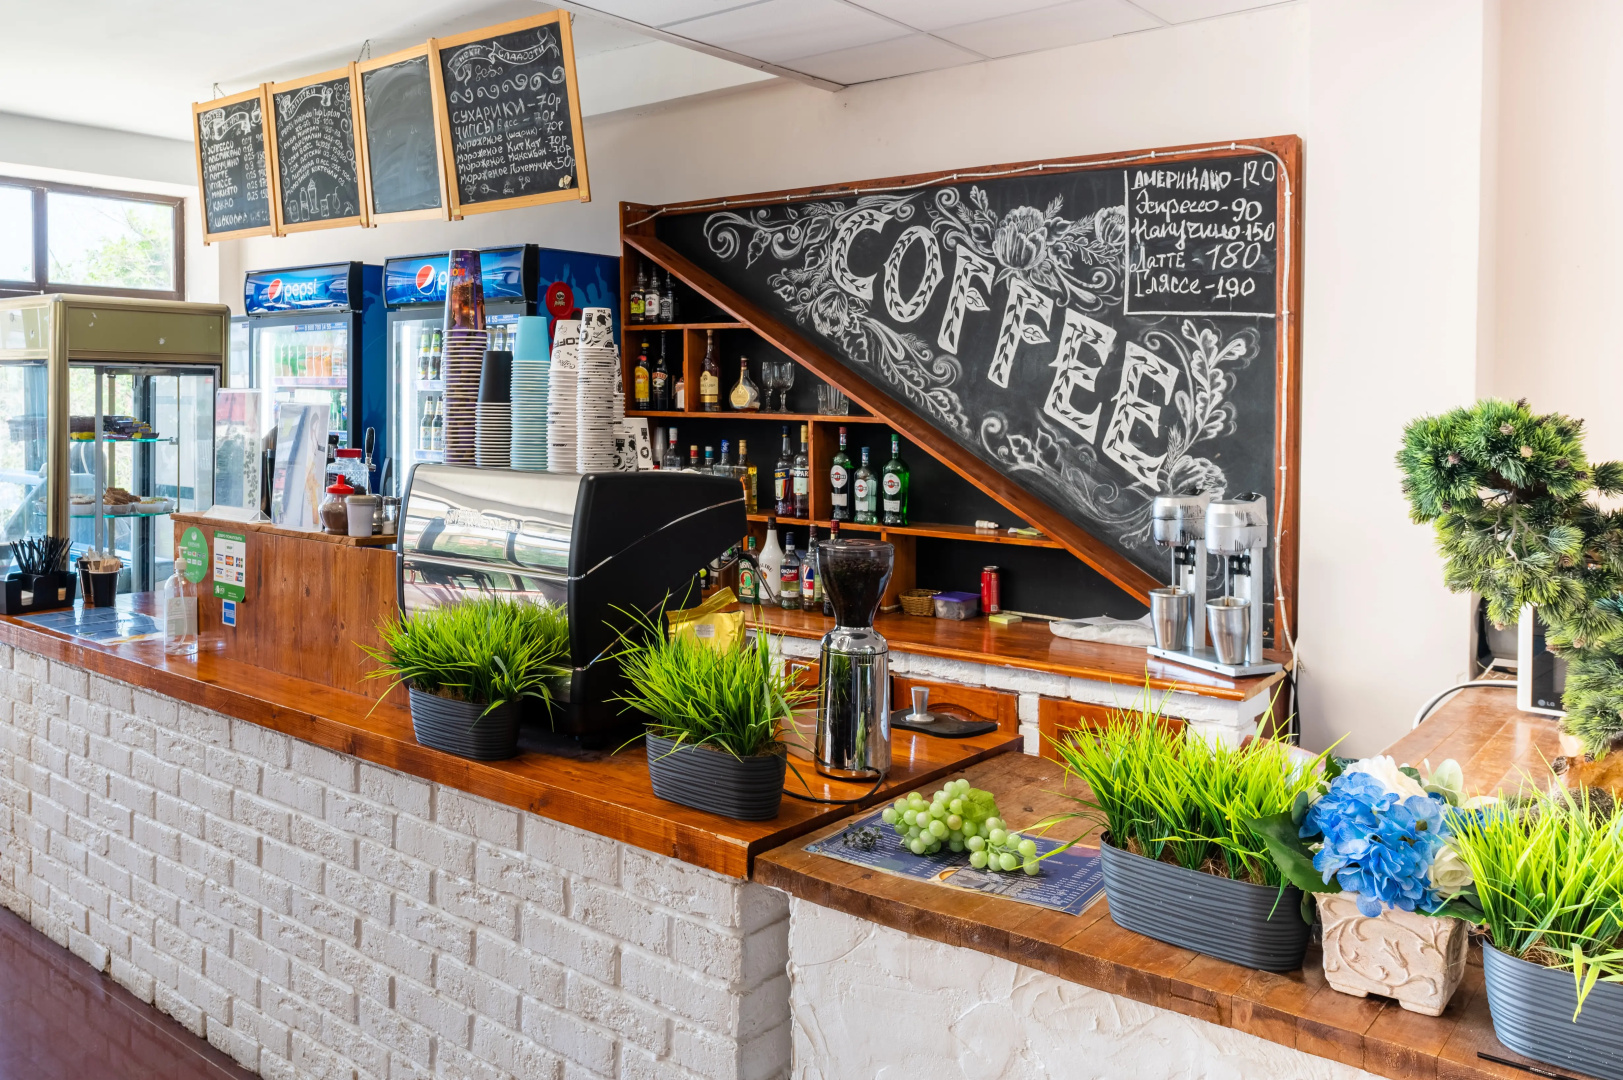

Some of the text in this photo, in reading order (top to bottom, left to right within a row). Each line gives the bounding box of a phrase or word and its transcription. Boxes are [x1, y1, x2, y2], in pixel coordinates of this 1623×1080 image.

[498, 45, 545, 60] СЛАДОСТИ
[288, 88, 316, 116] НАПИТКИ
[452, 97, 525, 124] СУХАРИКИ
[455, 119, 495, 140] ЧИПСЫ
[1131, 167, 1232, 192] АМЕРИКАНО
[1130, 245, 1186, 273] Латте
[1205, 241, 1261, 270] 180
[284, 278, 318, 303] pepsi
[1134, 269, 1201, 297] Гляссе
[831, 208, 1179, 491] COFFEE
